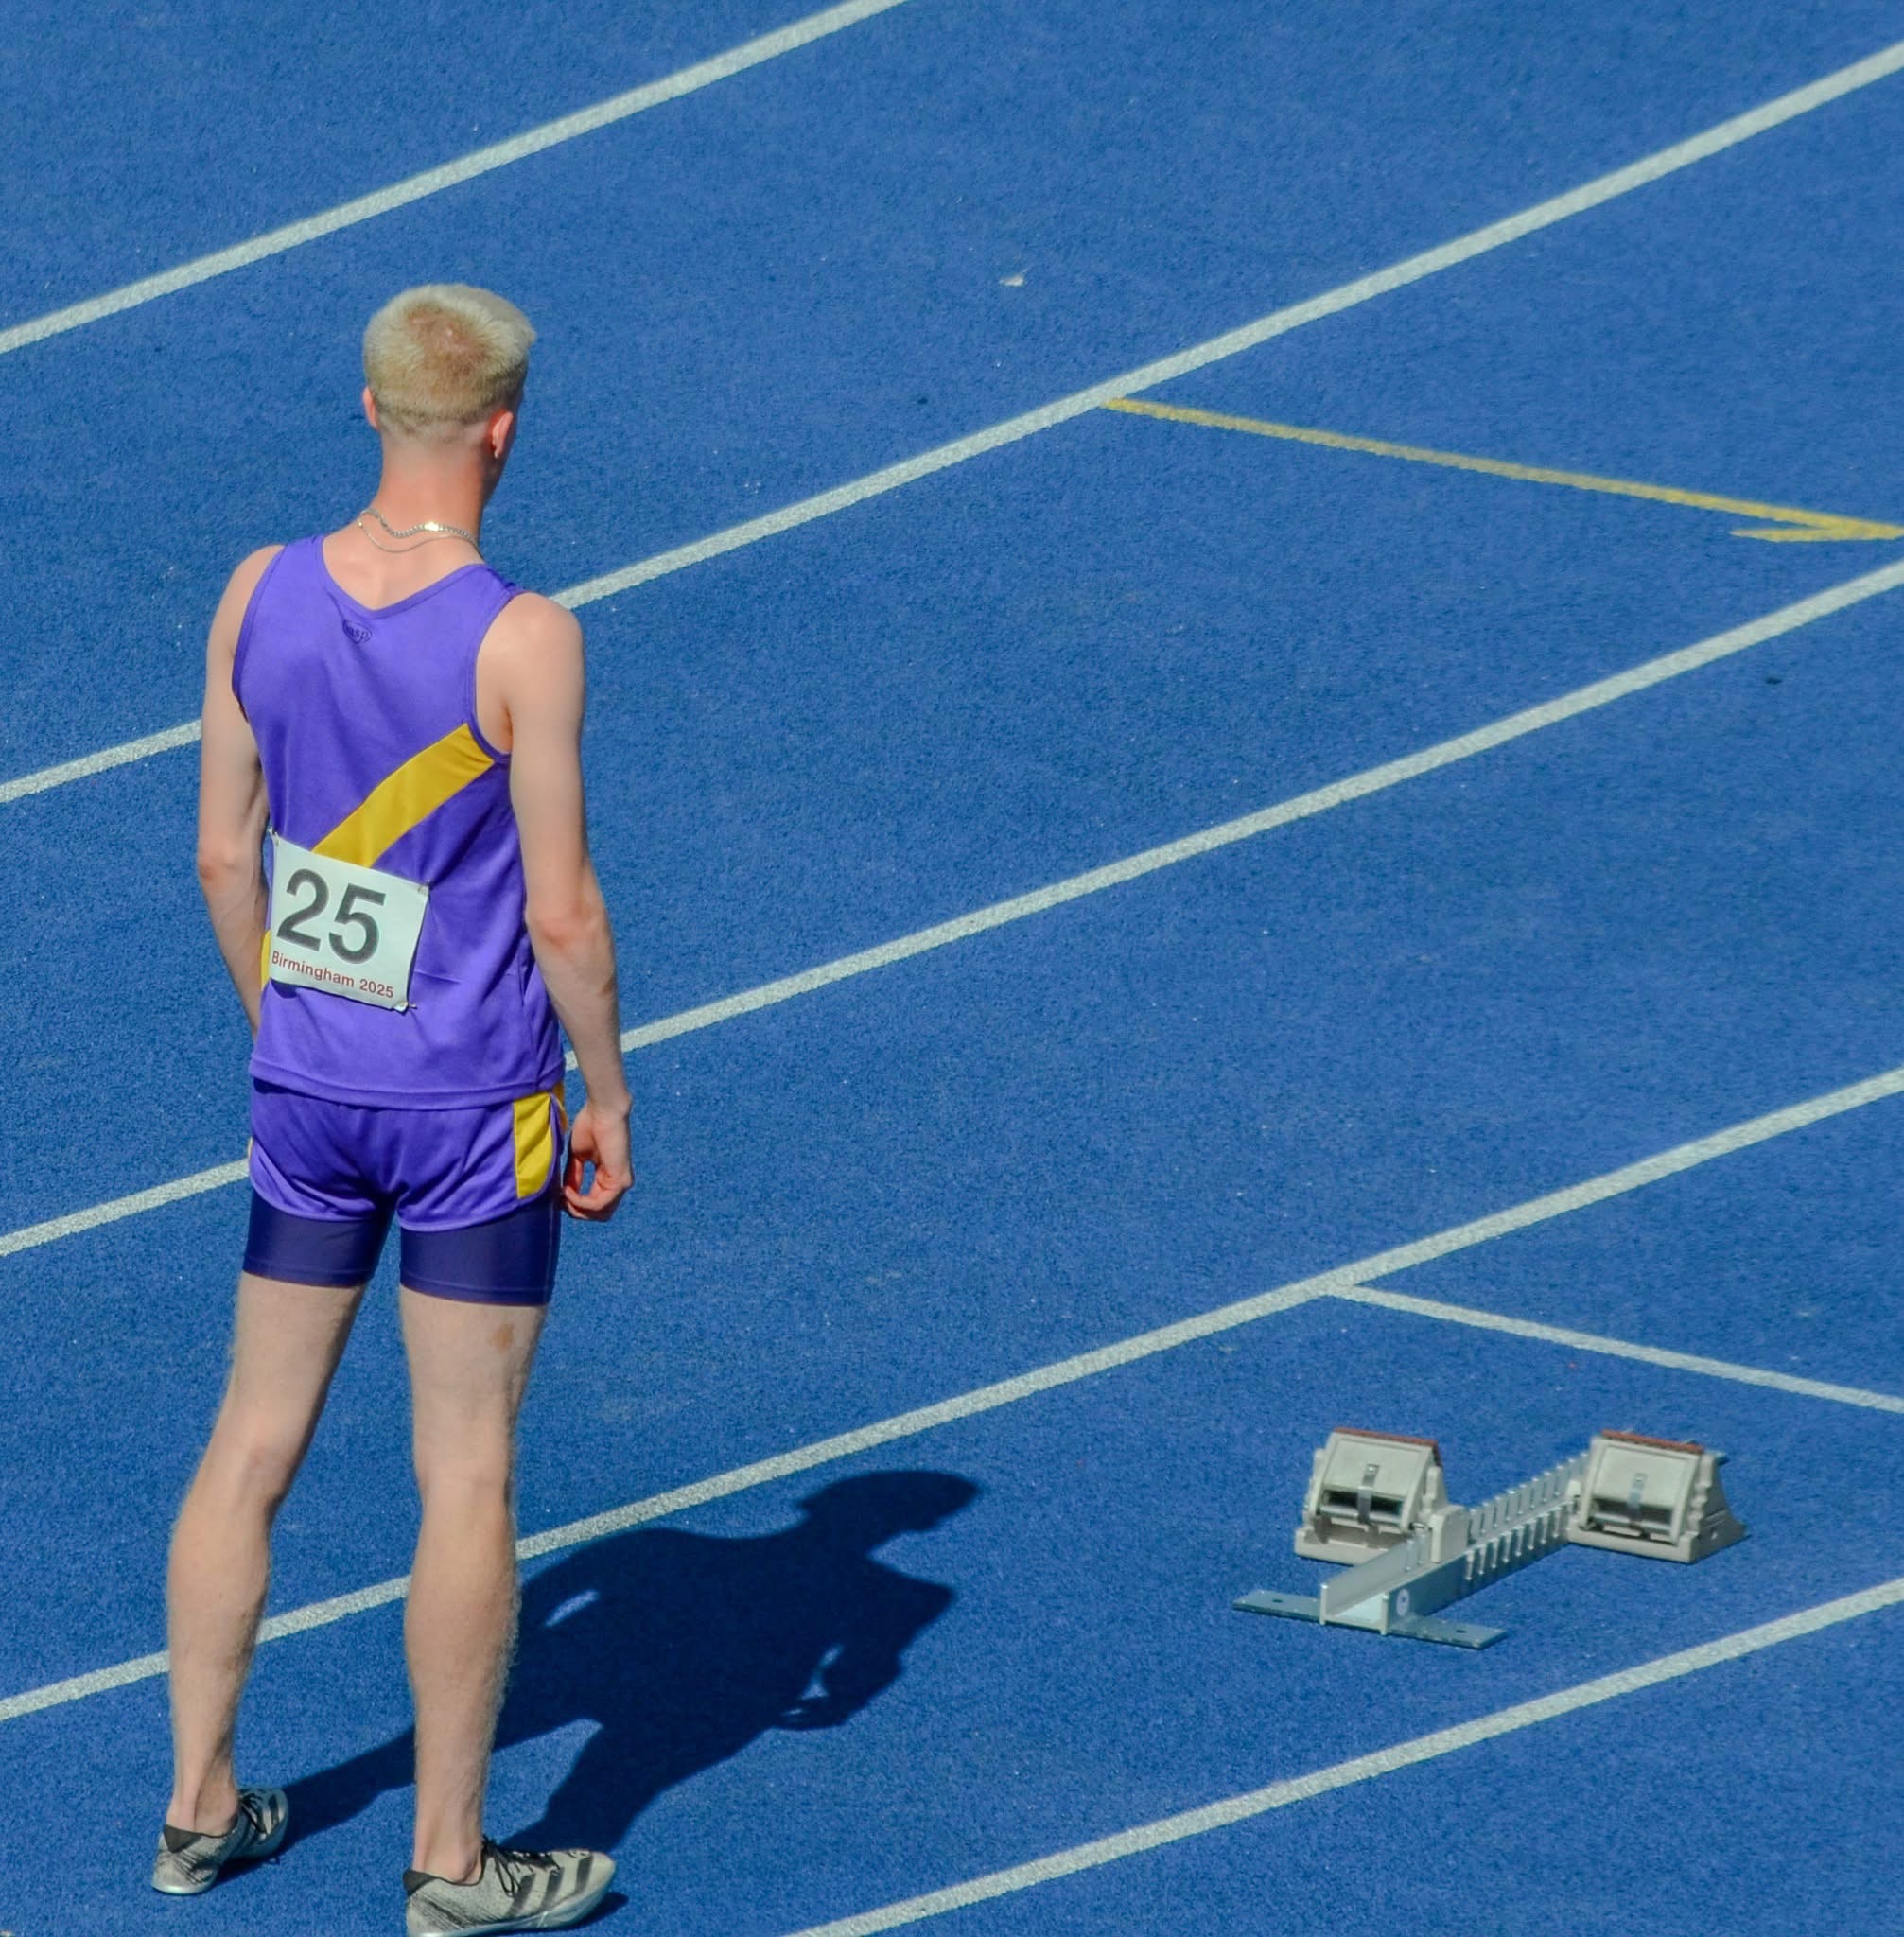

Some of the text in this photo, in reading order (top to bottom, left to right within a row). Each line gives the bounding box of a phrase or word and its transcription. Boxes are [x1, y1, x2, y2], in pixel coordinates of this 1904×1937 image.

[277, 868, 386, 964] 25
[271, 951, 393, 998] Birmingham 2025
